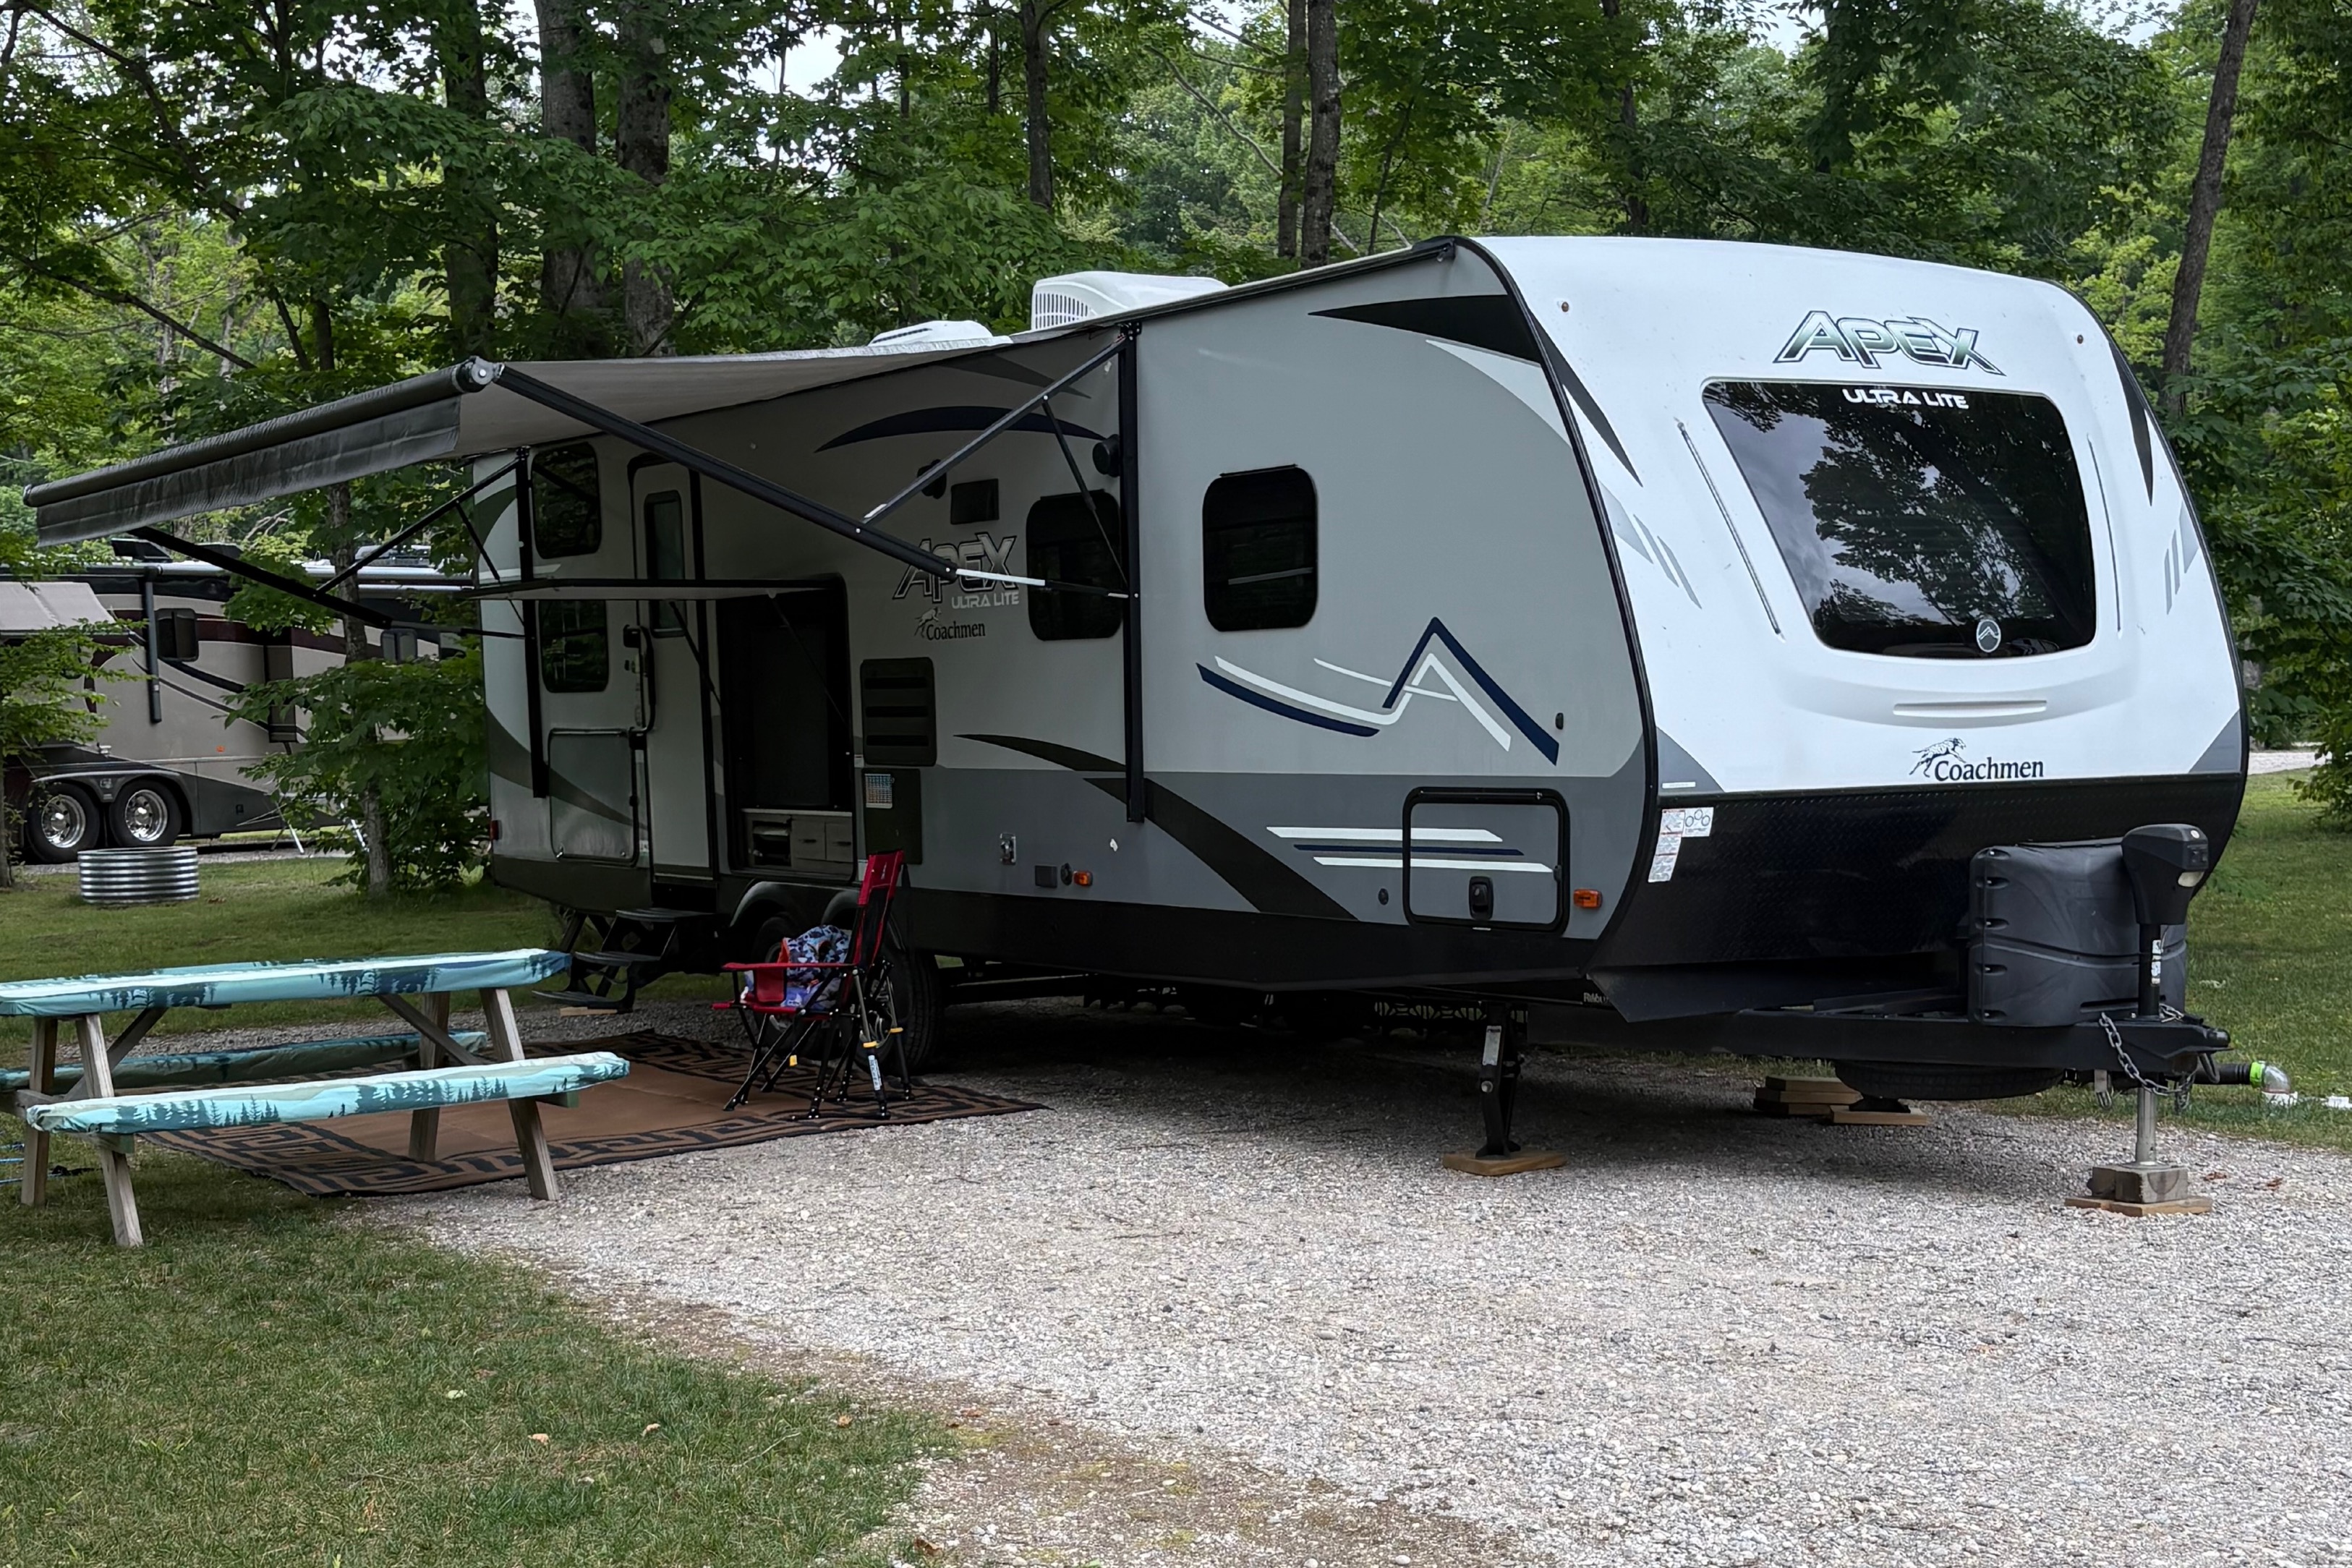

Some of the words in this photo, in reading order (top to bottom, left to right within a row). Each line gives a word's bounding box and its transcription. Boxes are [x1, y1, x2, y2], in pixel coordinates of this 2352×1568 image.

[1772, 310, 2007, 377] APEX
[1842, 388, 1920, 406] ULTRA
[1922, 391, 1969, 409] LITE
[951, 595, 991, 609] ULTRA
[993, 592, 1020, 607] LITE
[926, 621, 987, 641] Coachmen
[1934, 757, 2044, 782] Coachmen
